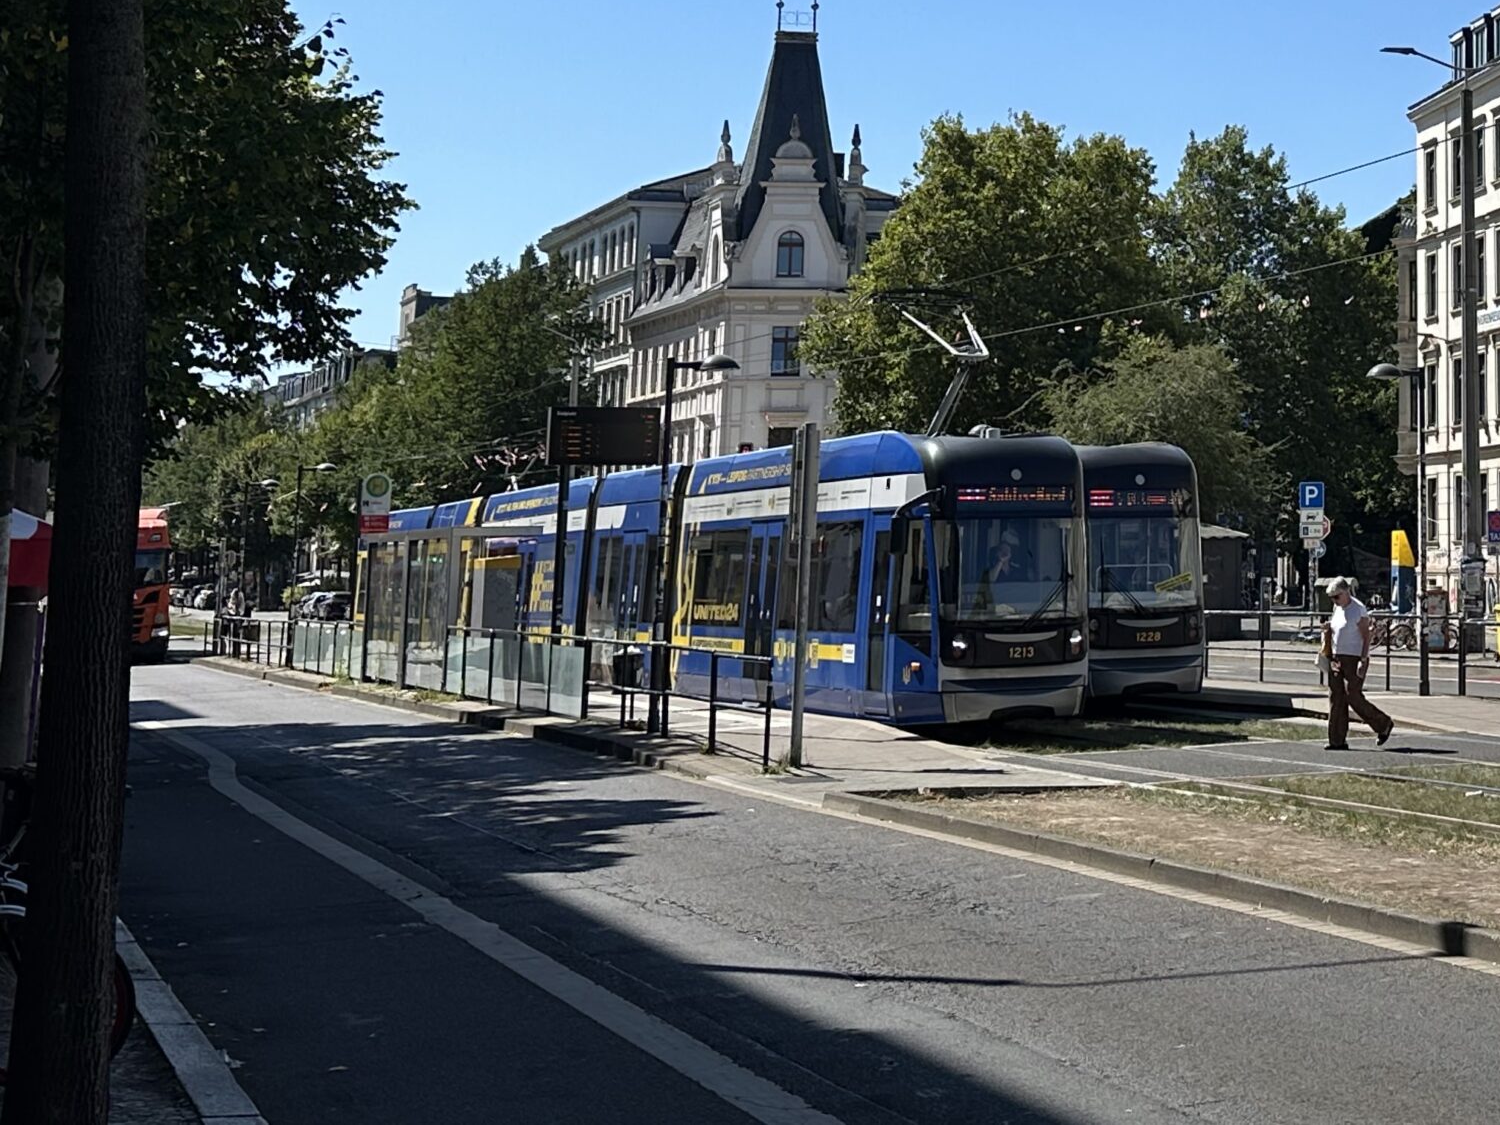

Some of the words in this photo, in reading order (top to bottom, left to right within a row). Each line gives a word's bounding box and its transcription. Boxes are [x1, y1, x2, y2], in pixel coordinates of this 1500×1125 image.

[1305, 486, 1319, 506] P
[693, 603, 739, 621] UNITED24
[1136, 632, 1162, 642] 1228
[1009, 647, 1035, 658] 1213
